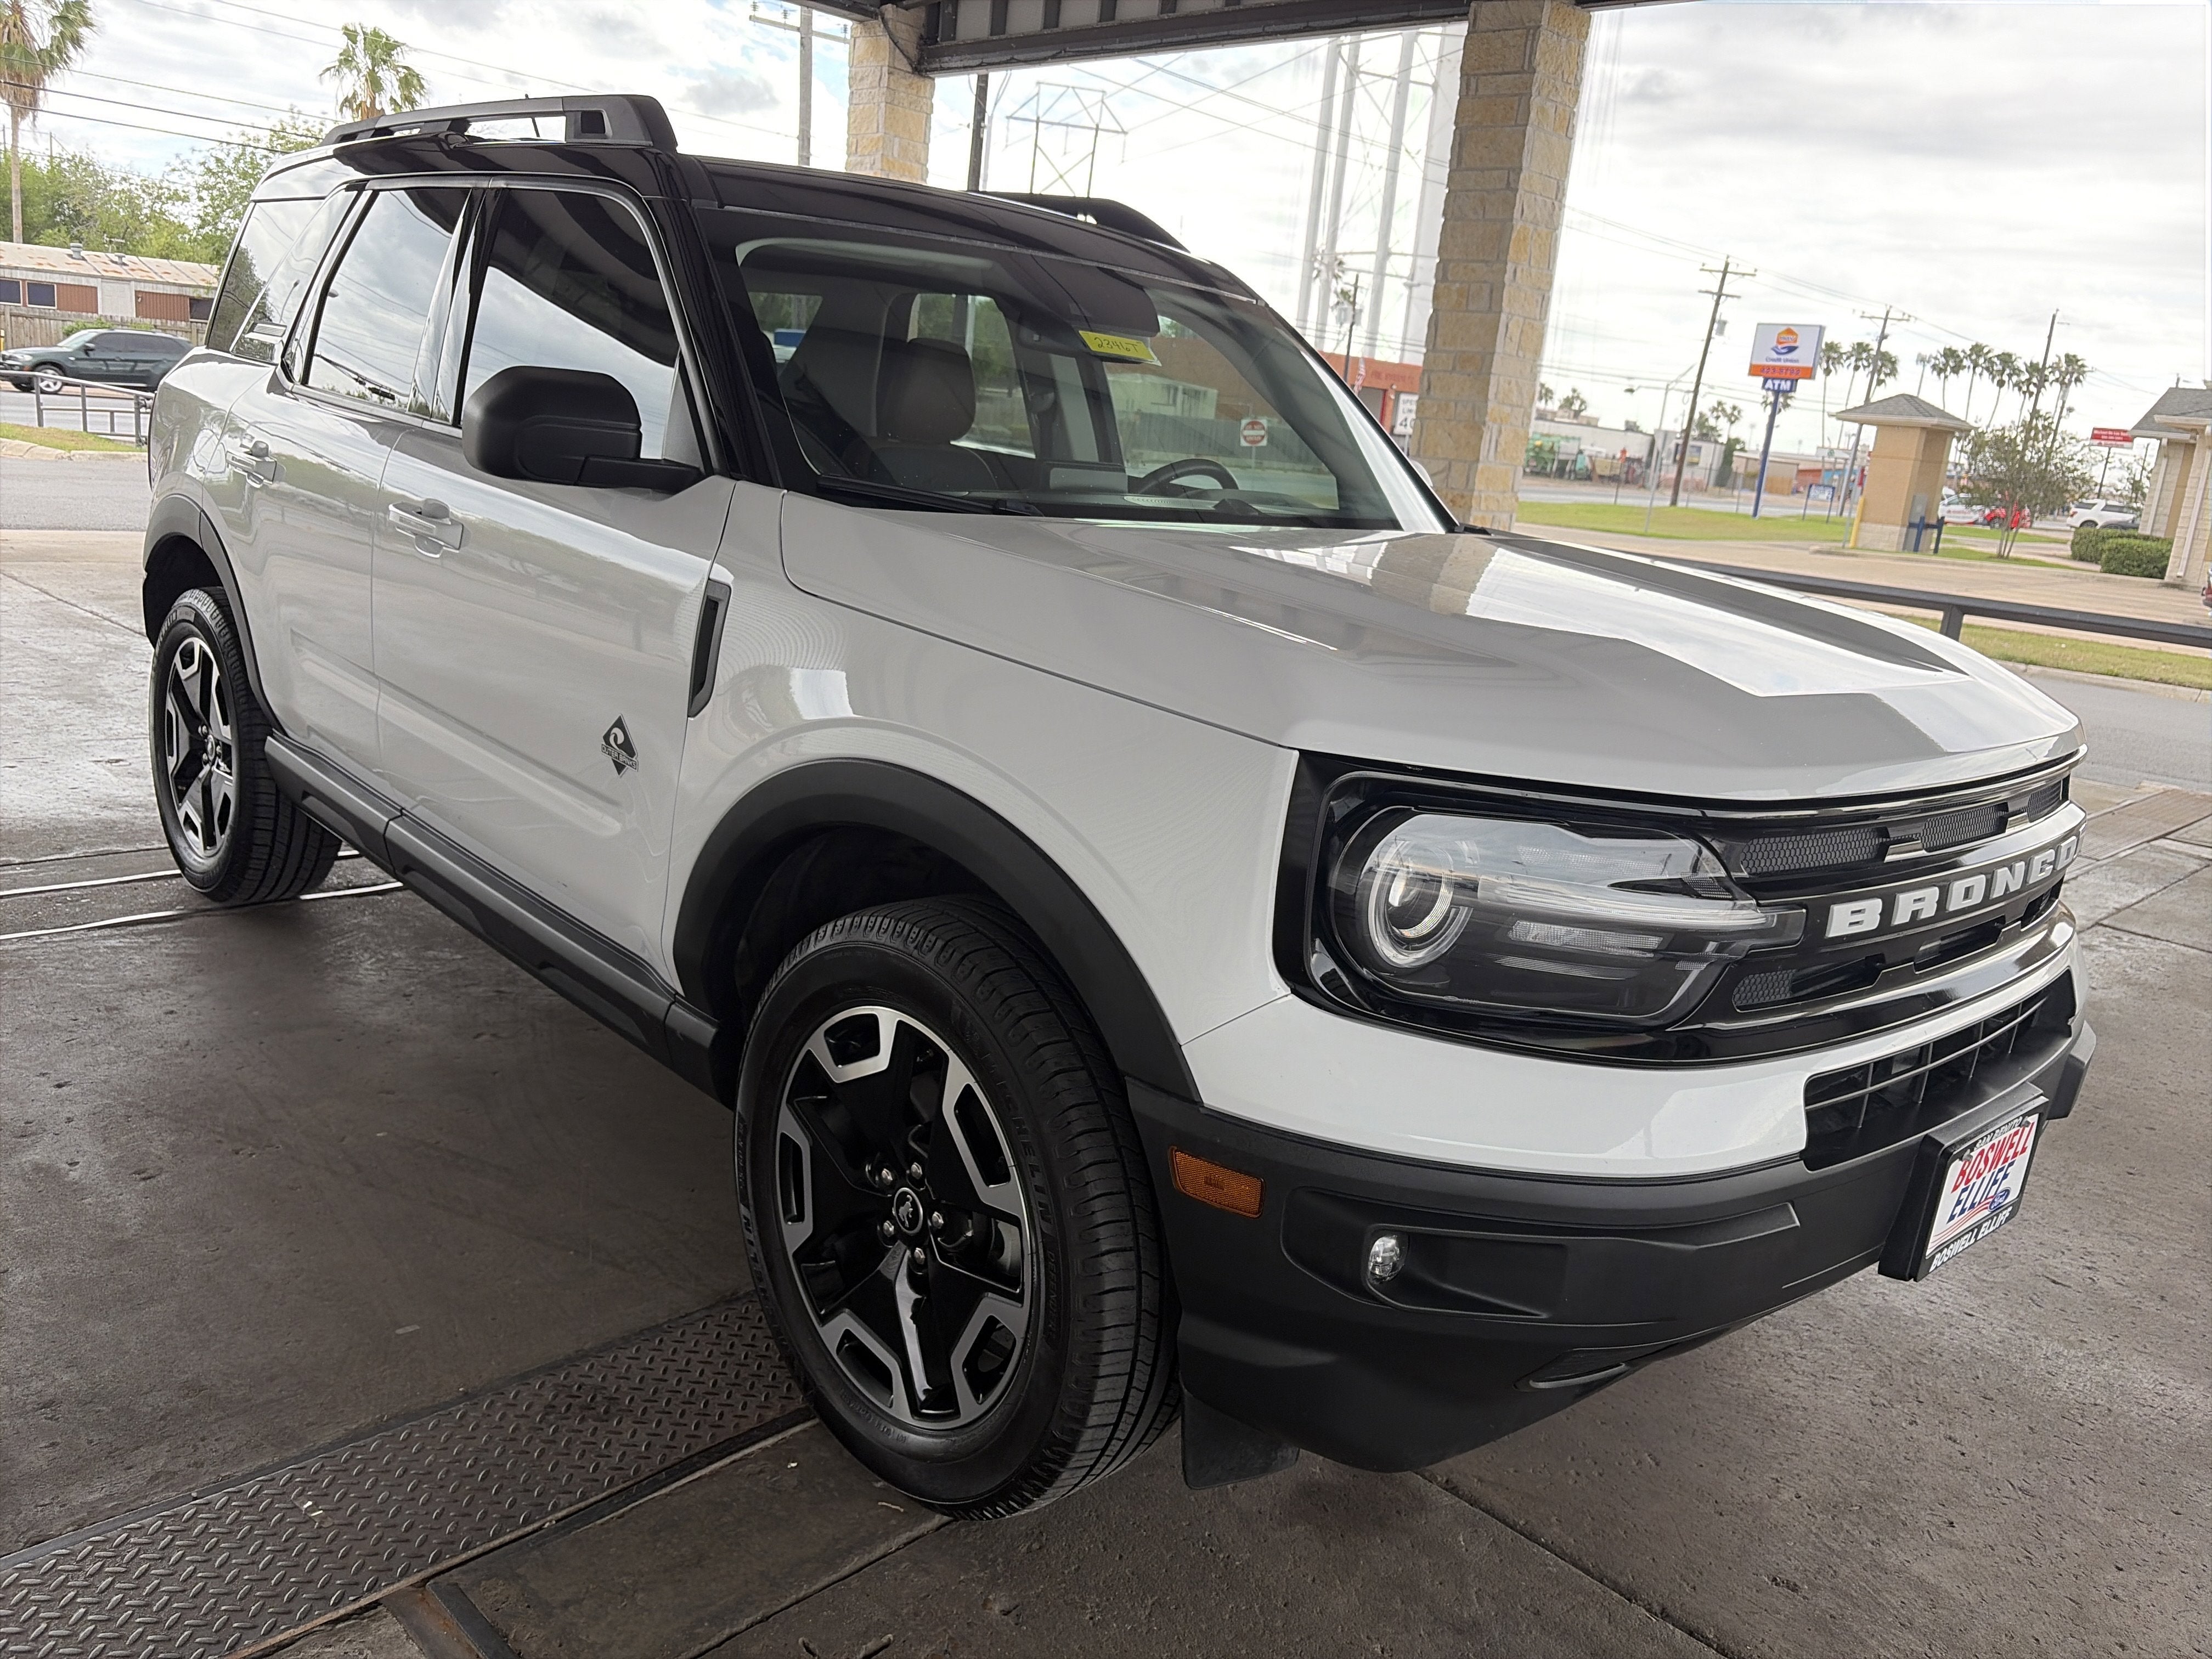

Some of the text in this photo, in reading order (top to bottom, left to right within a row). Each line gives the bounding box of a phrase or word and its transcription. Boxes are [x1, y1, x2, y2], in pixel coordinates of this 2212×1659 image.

[1764, 379, 1791, 391] ATM
[602, 745, 636, 769] OUTER BANKS
[1825, 836, 2077, 938] BRONCO
[1951, 1121, 2035, 1194] BOSWELL
[1975, 1116, 2023, 1149] SAN BENITO
[1946, 1159, 2017, 1224] ELLIFF
[1929, 1206, 2013, 1273] BOSWELL ELLIFF
